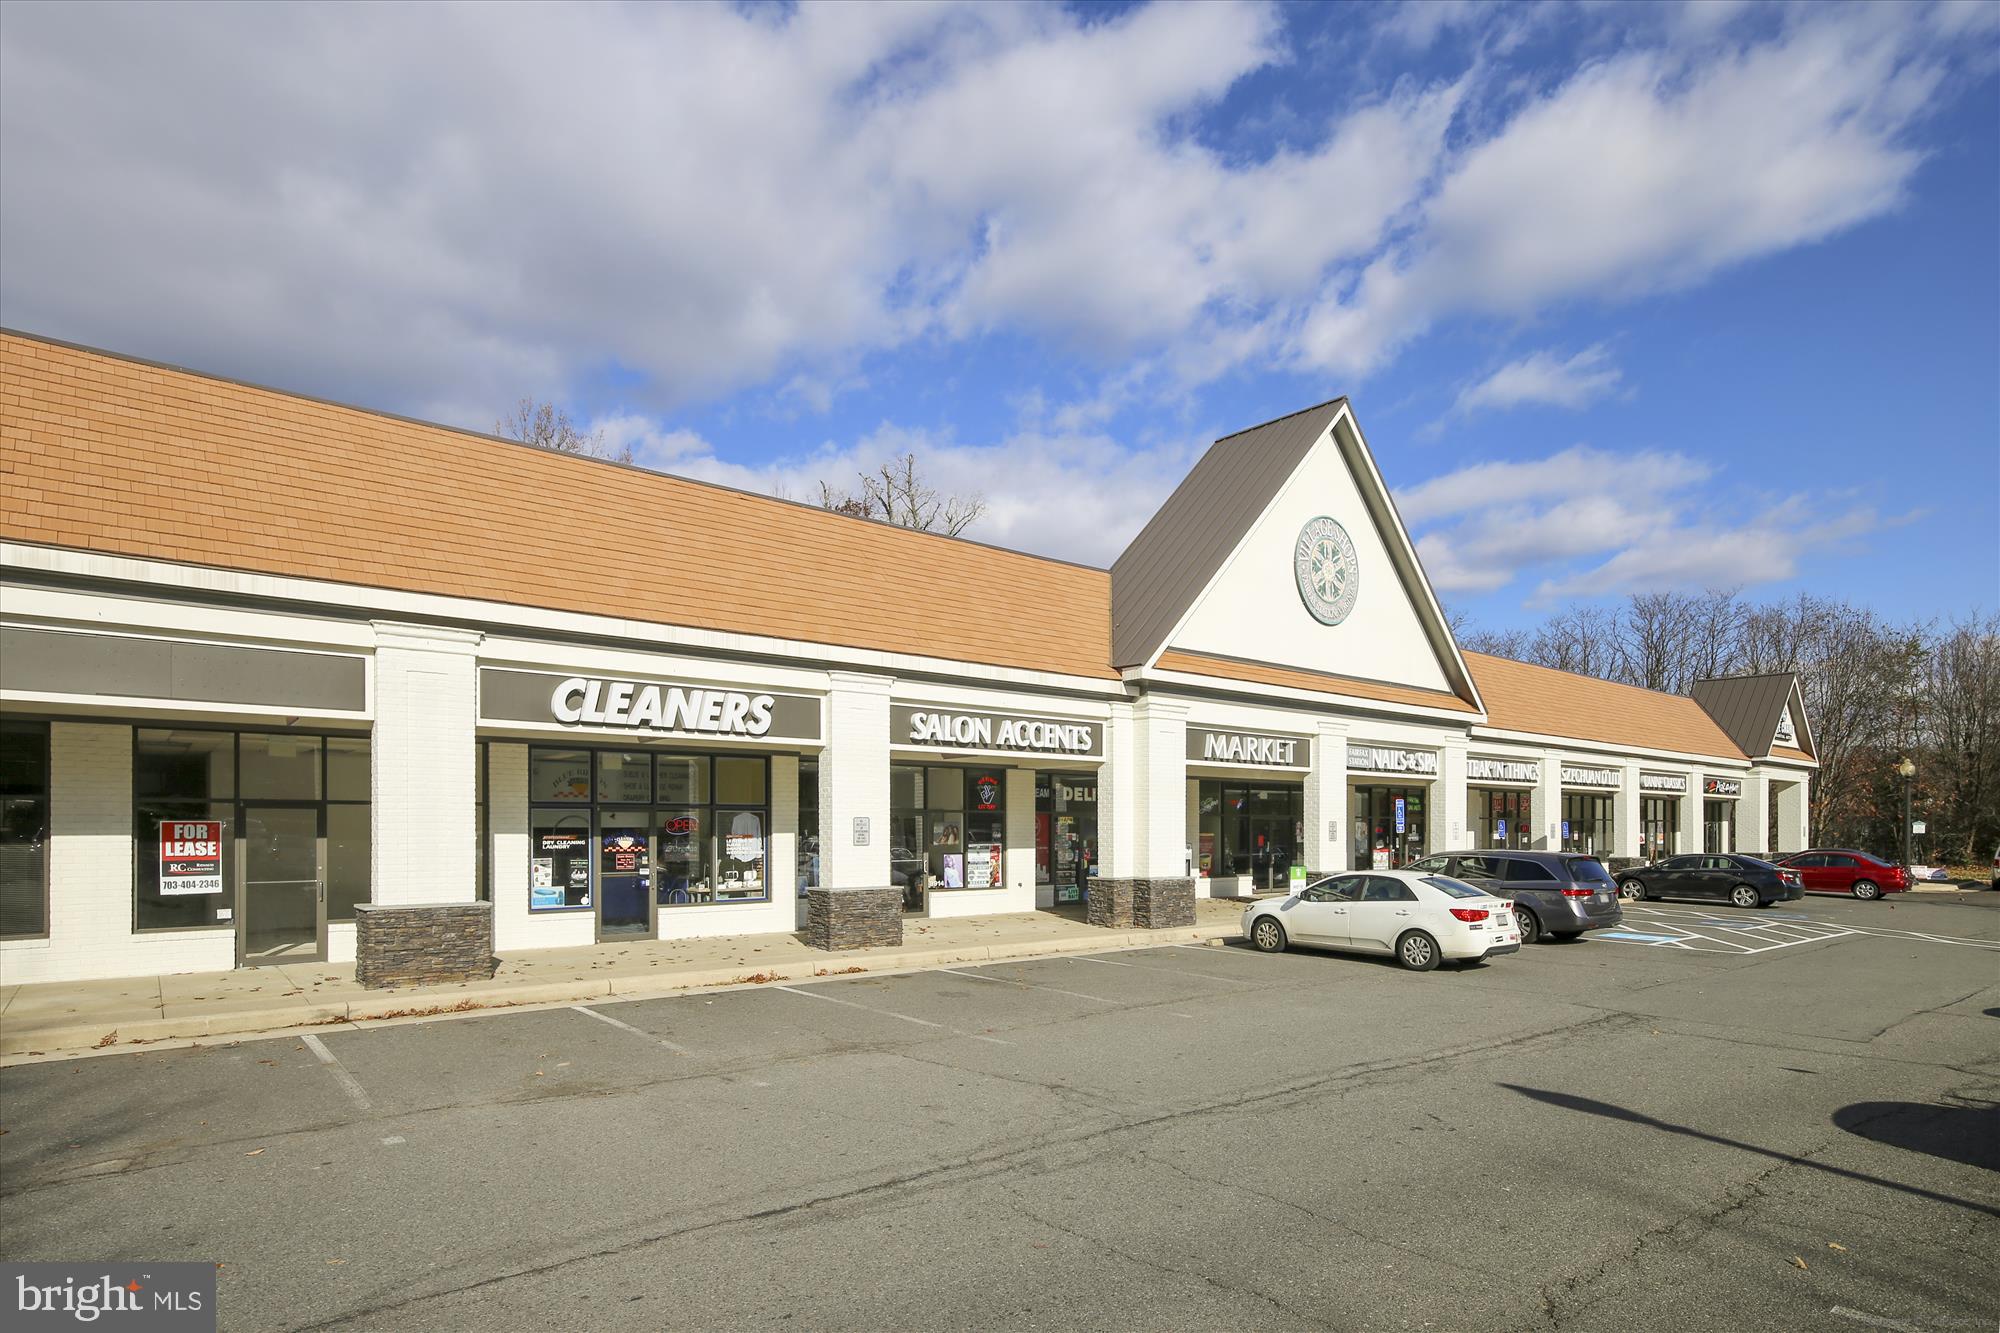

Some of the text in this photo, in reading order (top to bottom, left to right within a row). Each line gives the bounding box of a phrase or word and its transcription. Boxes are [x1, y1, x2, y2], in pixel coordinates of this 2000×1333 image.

[1299, 519, 1357, 573] VILLAGE SHOPS
[551, 677, 775, 735] CLEANERS
[910, 712, 1092, 751] SALON ACCENTS
[1204, 733, 1297, 763] MARKET
[1372, 748, 1406, 770] NAILS
[1415, 751, 1437, 772] SPA
[1063, 786, 1096, 801] DELI
[174, 824, 208, 839] FOR
[666, 819, 698, 832] OPEN
[165, 841, 217, 856] LEASE
[169, 863, 187, 872] RC
[163, 879, 219, 890] 703-404-2346
